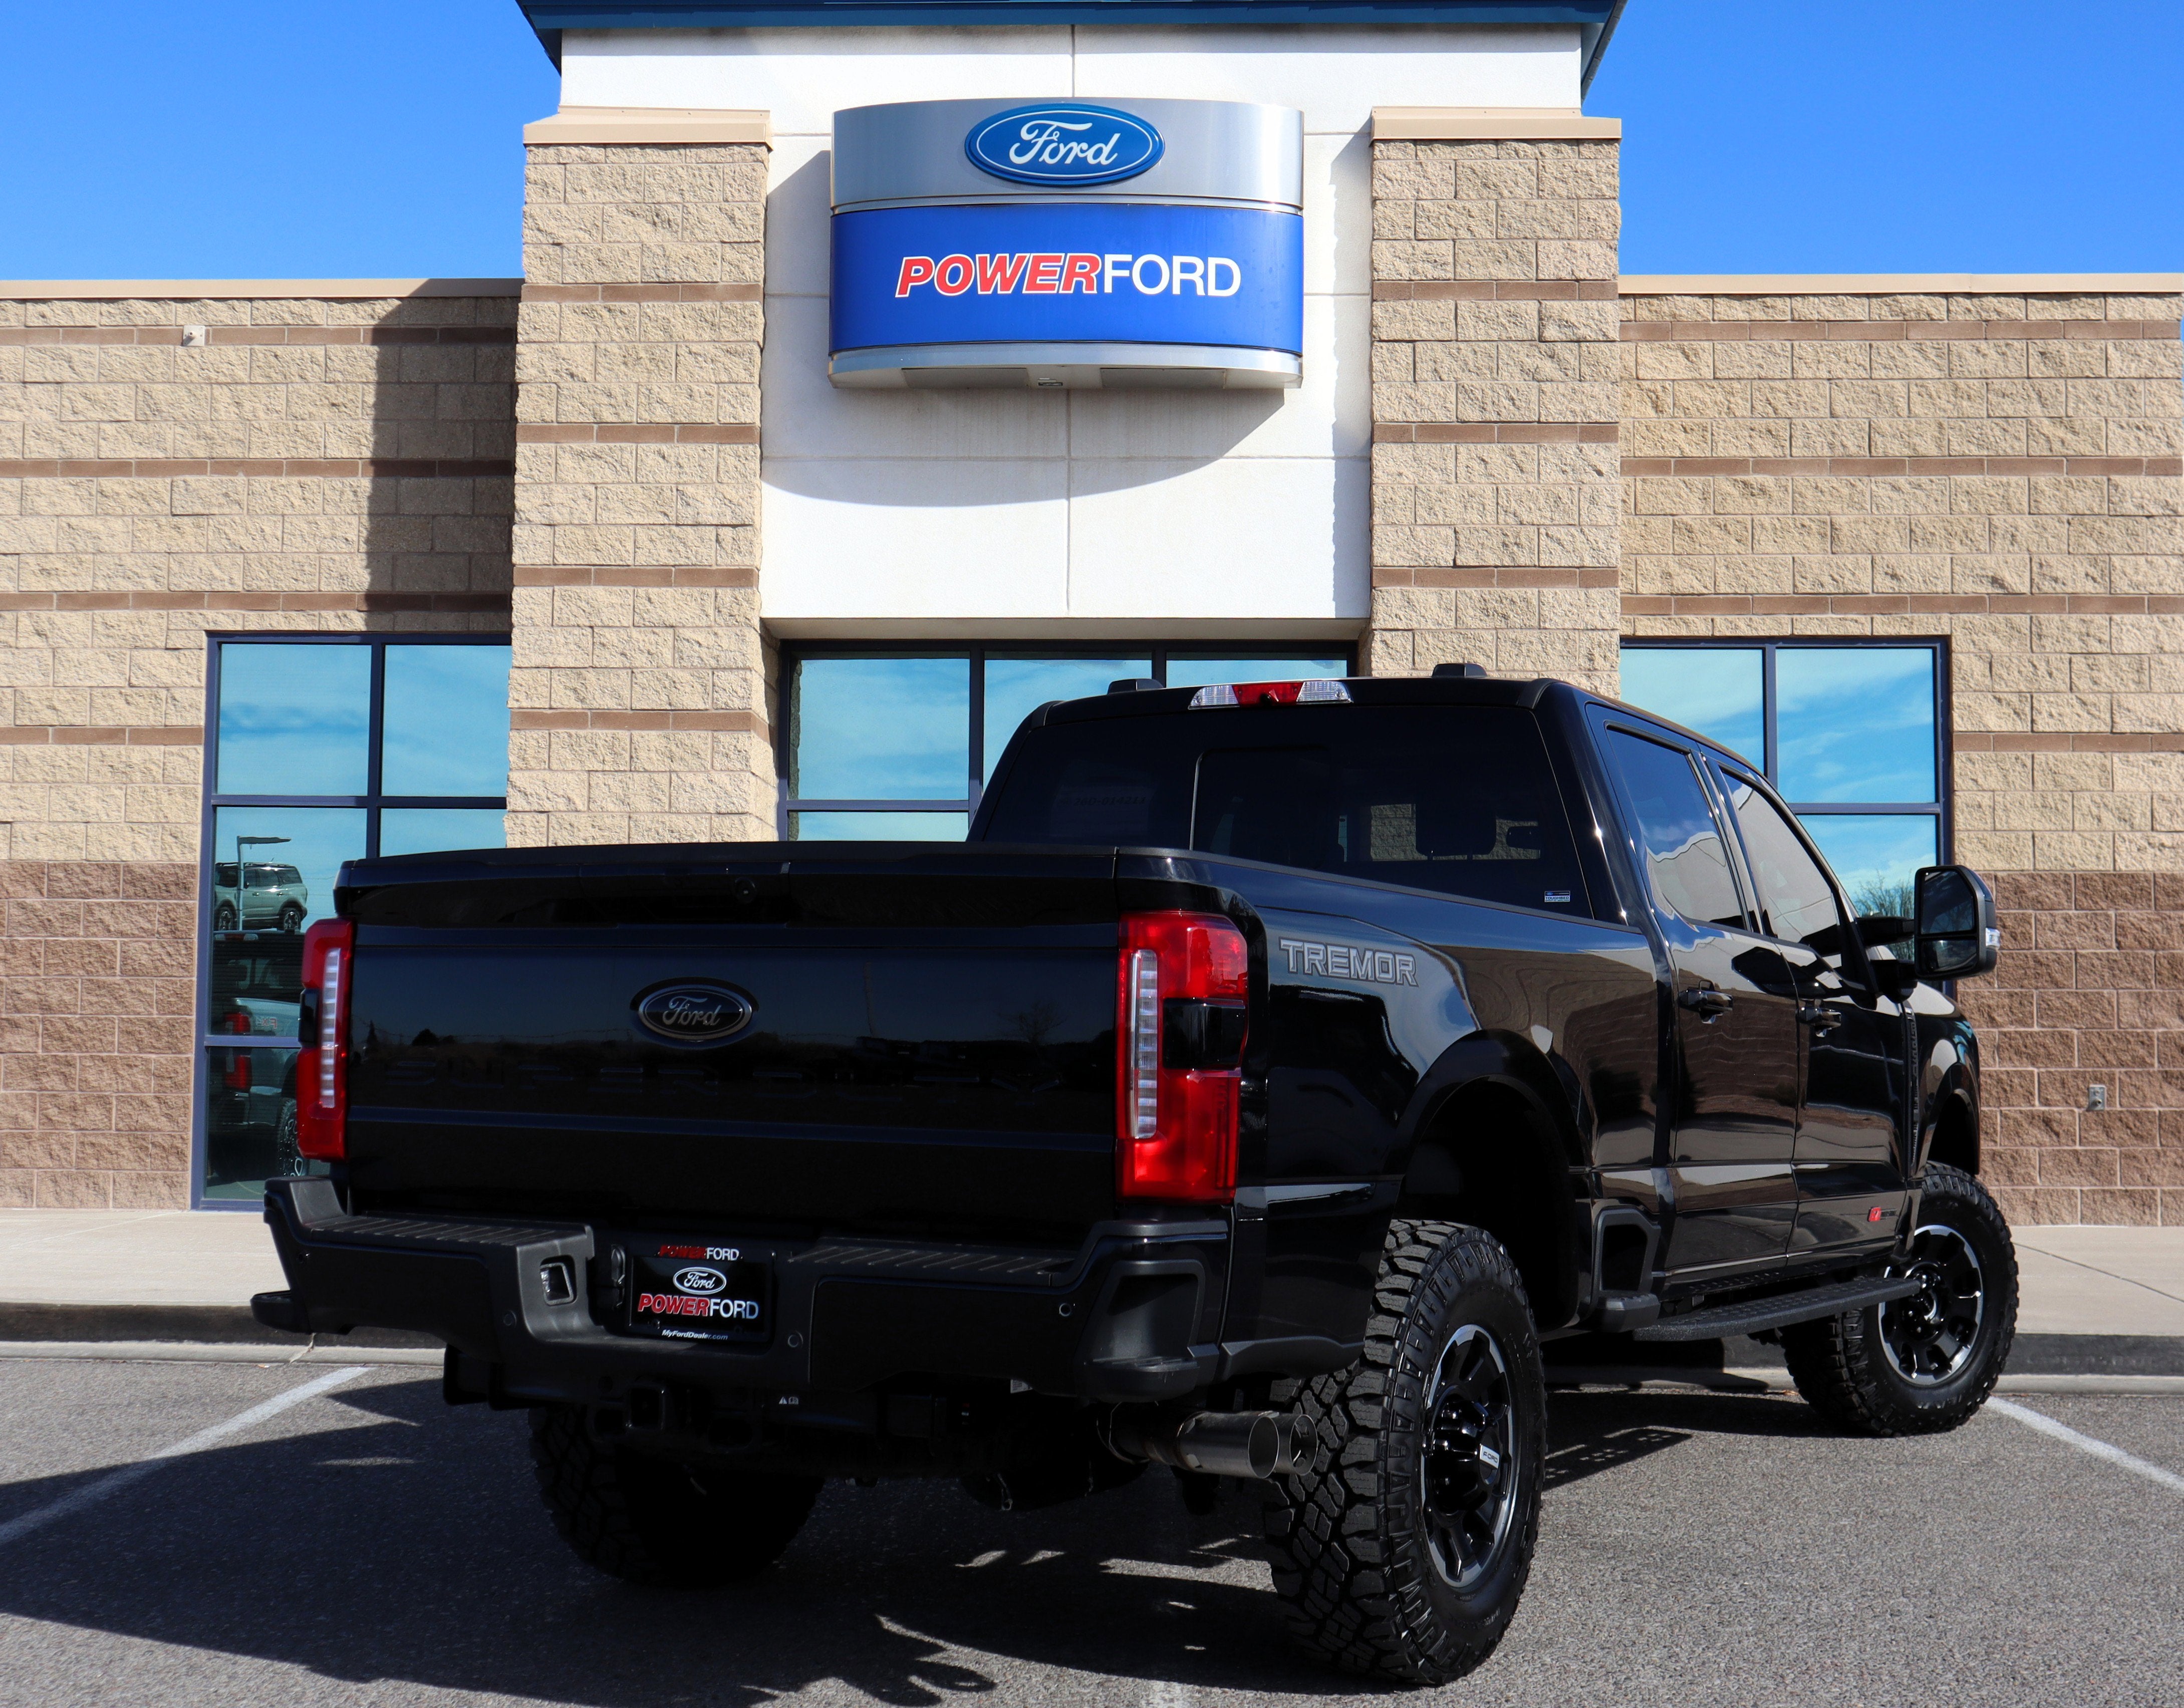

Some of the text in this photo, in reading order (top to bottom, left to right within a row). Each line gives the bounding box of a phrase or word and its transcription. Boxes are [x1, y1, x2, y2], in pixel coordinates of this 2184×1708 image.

[1009, 120, 1121, 165] Ford
[1279, 936, 1419, 987] TREMOR
[662, 996, 722, 1026] Ford
[683, 1272, 715, 1289] Ford
[661, 1329, 728, 1341] MyFordDealer.com
[1483, 1451, 1498, 1463] FORD
